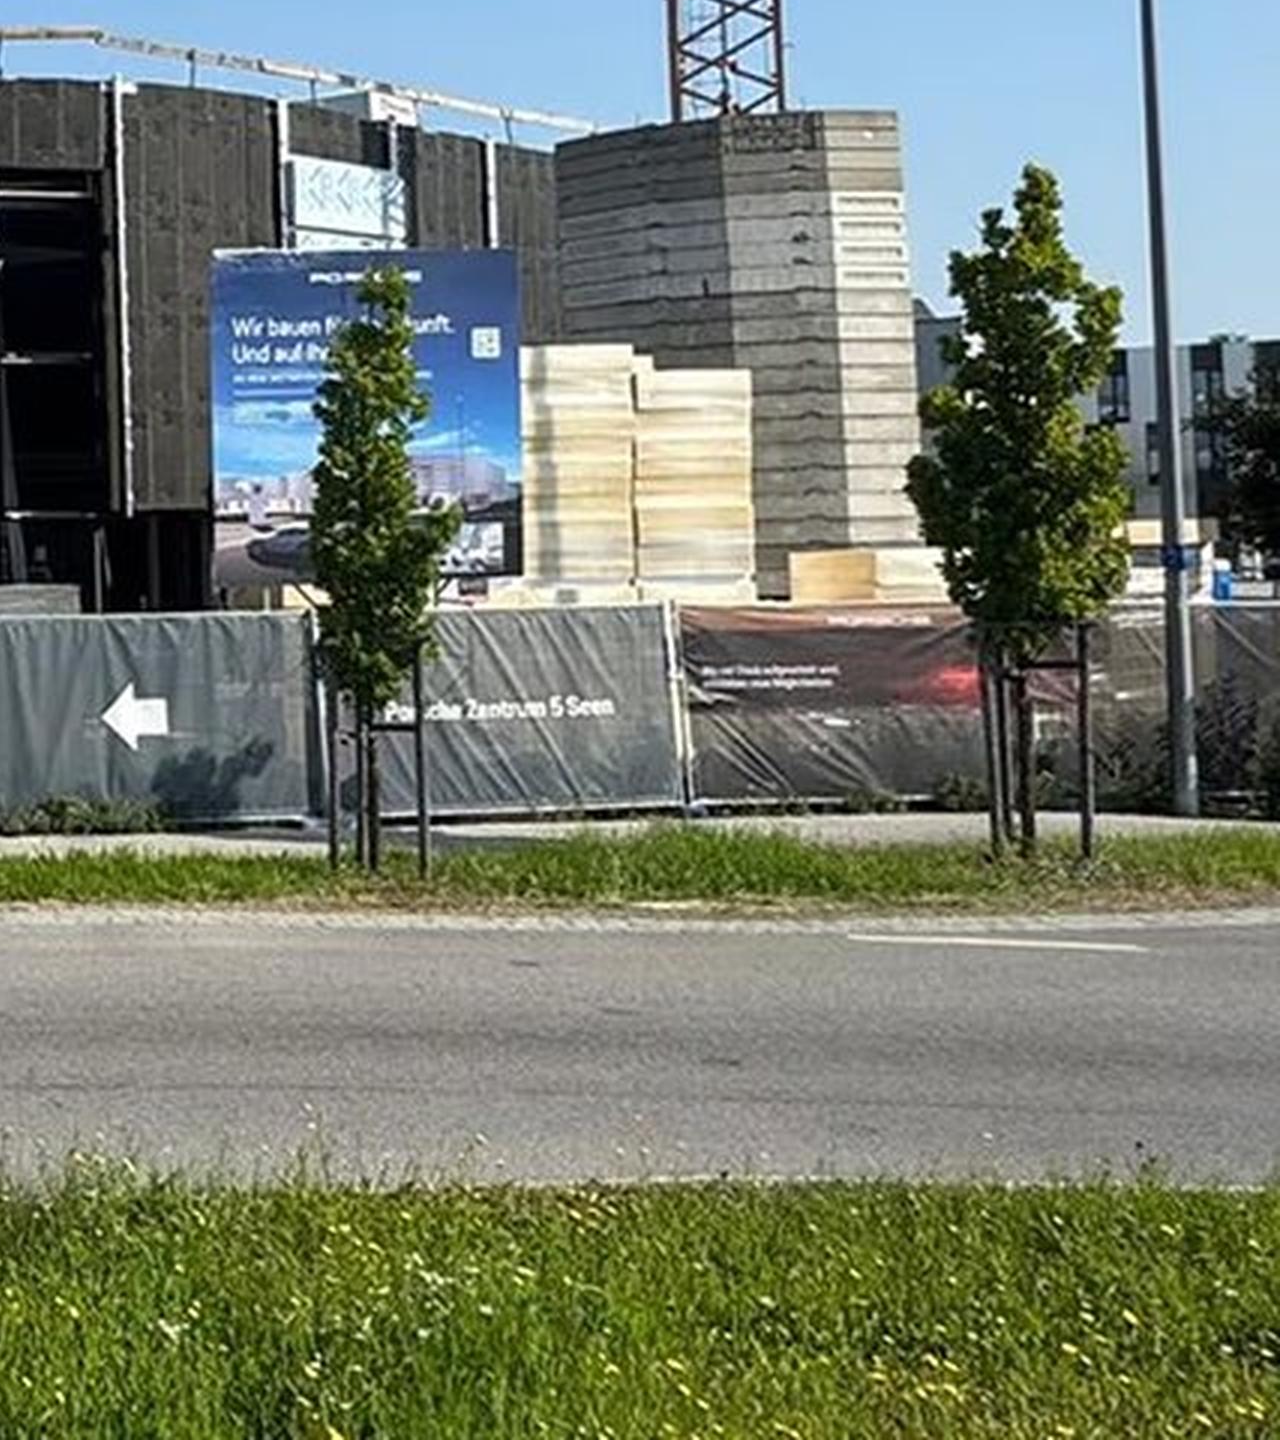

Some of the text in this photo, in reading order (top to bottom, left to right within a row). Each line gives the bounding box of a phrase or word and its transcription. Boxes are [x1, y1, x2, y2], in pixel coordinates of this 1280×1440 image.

[230, 316, 264, 337] Wir
[267, 316, 321, 336] bauen
[230, 343, 271, 364] Und
[274, 343, 303, 363] auf
[548, 695, 563, 718] 5
[565, 694, 616, 718] Seen
